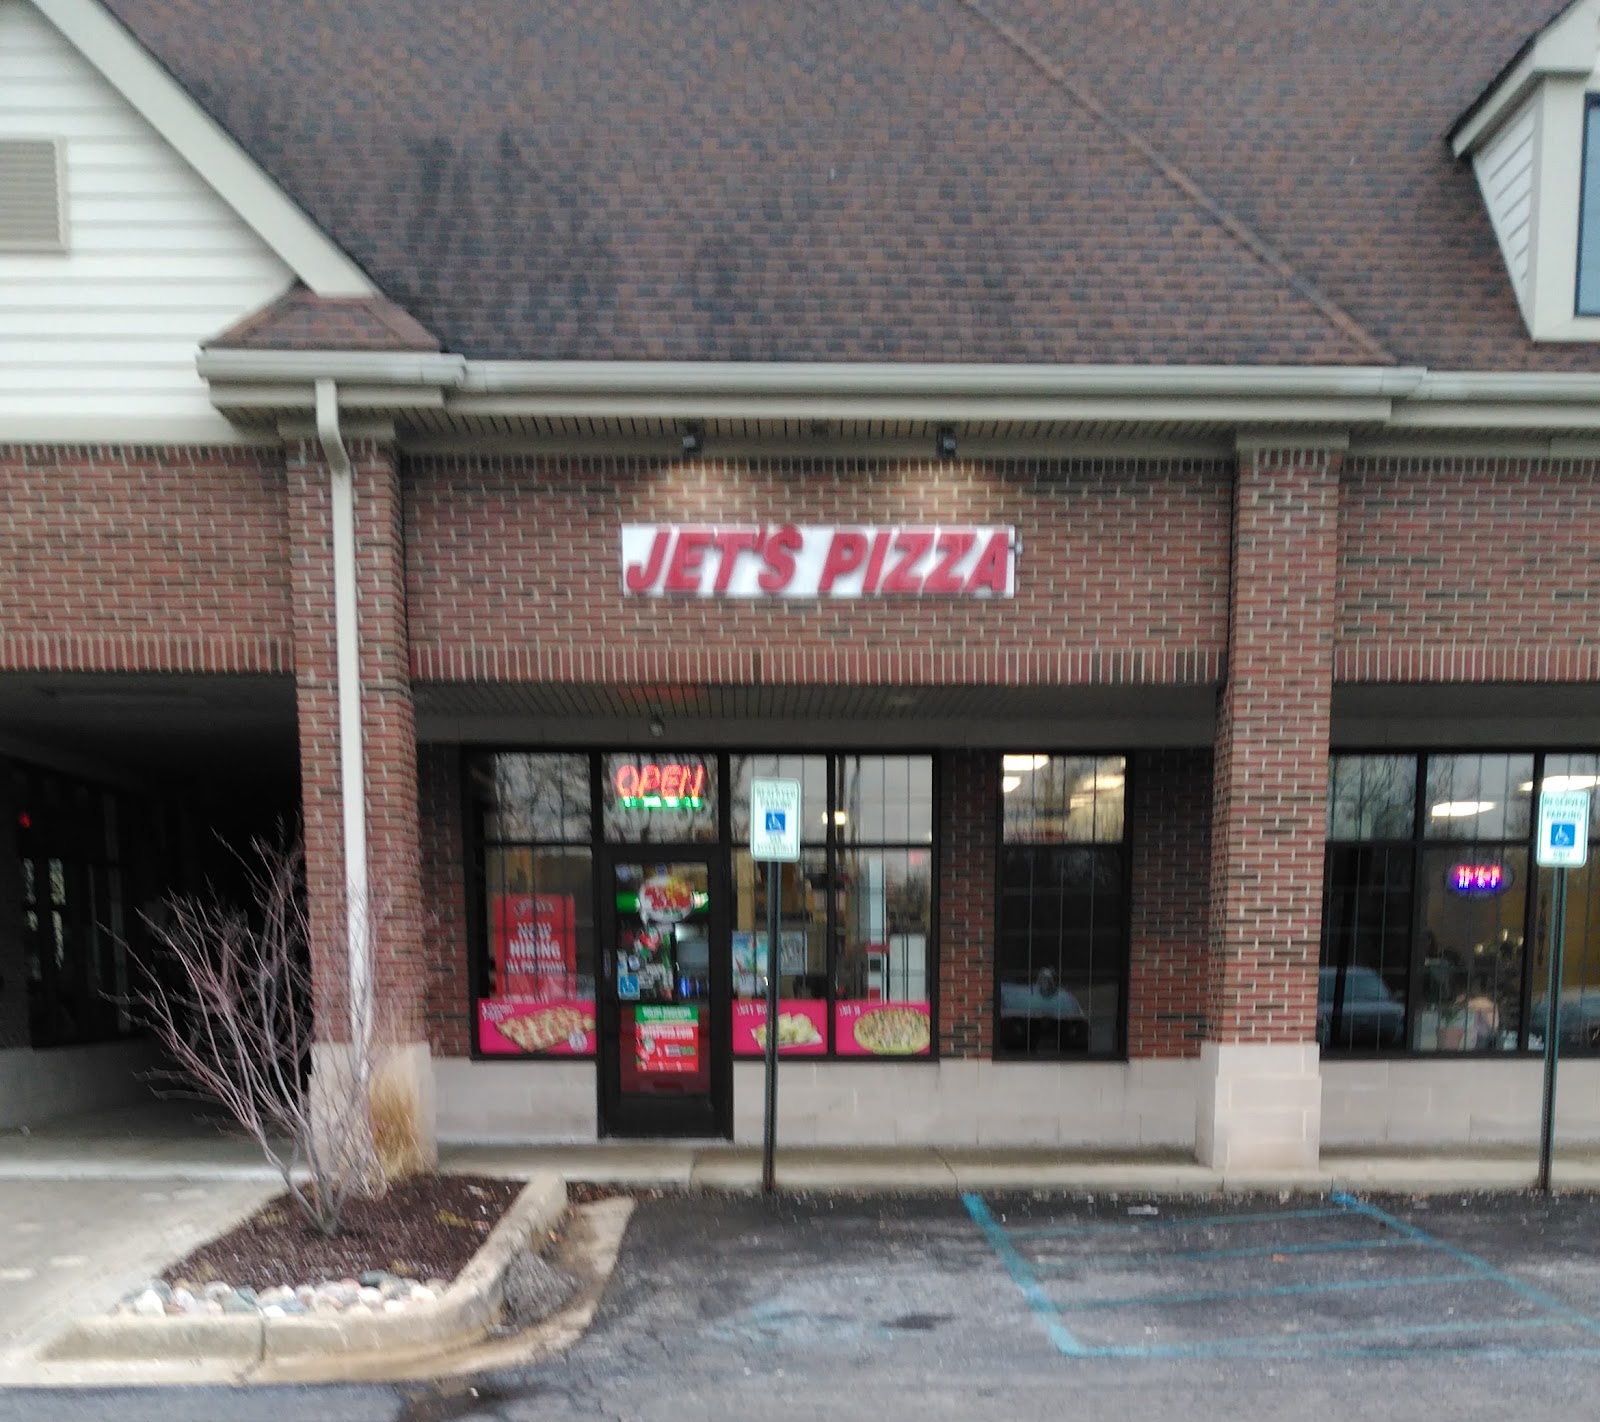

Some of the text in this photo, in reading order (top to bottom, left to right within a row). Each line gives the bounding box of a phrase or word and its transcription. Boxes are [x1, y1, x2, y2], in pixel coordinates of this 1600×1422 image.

[625, 523, 1010, 594] JET'S PIZZA
[616, 764, 704, 799] OPEN
